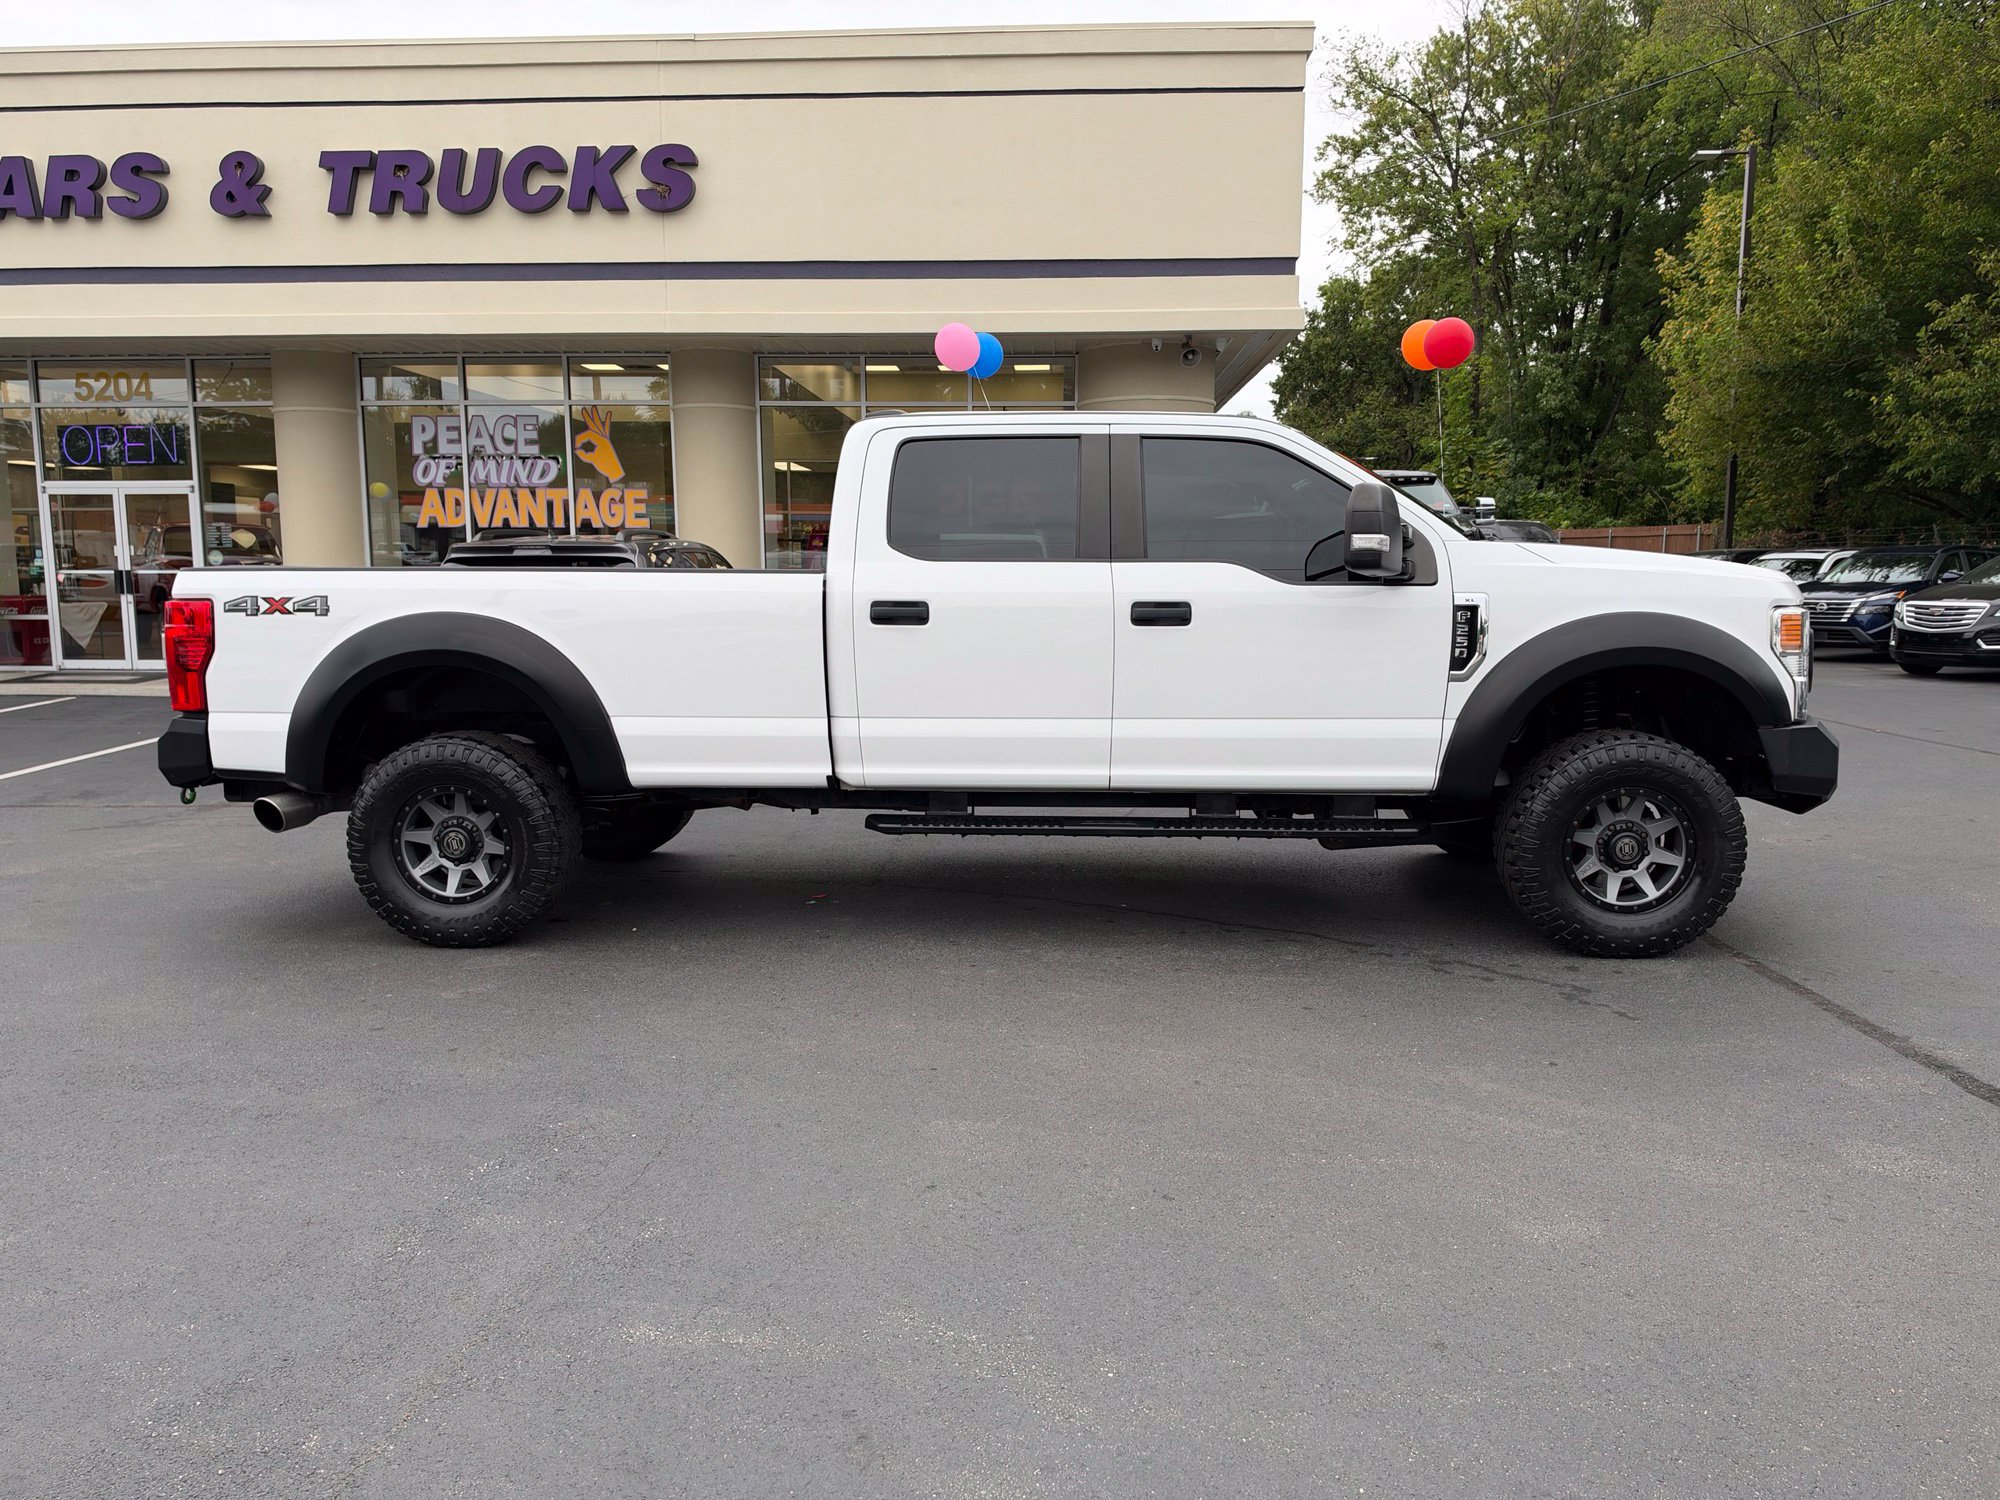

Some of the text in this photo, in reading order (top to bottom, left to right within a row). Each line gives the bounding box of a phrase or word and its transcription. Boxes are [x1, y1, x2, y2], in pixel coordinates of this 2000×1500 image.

[209, 150, 272, 217] &
[318, 143, 698, 216] TRUCKS
[74, 372, 152, 402] 5204
[62, 425, 178, 465] OPEN
[411, 414, 539, 456] PEACE
[413, 457, 459, 487] OF
[470, 458, 560, 487] MIND
[416, 488, 650, 529] ADVANTAGE
